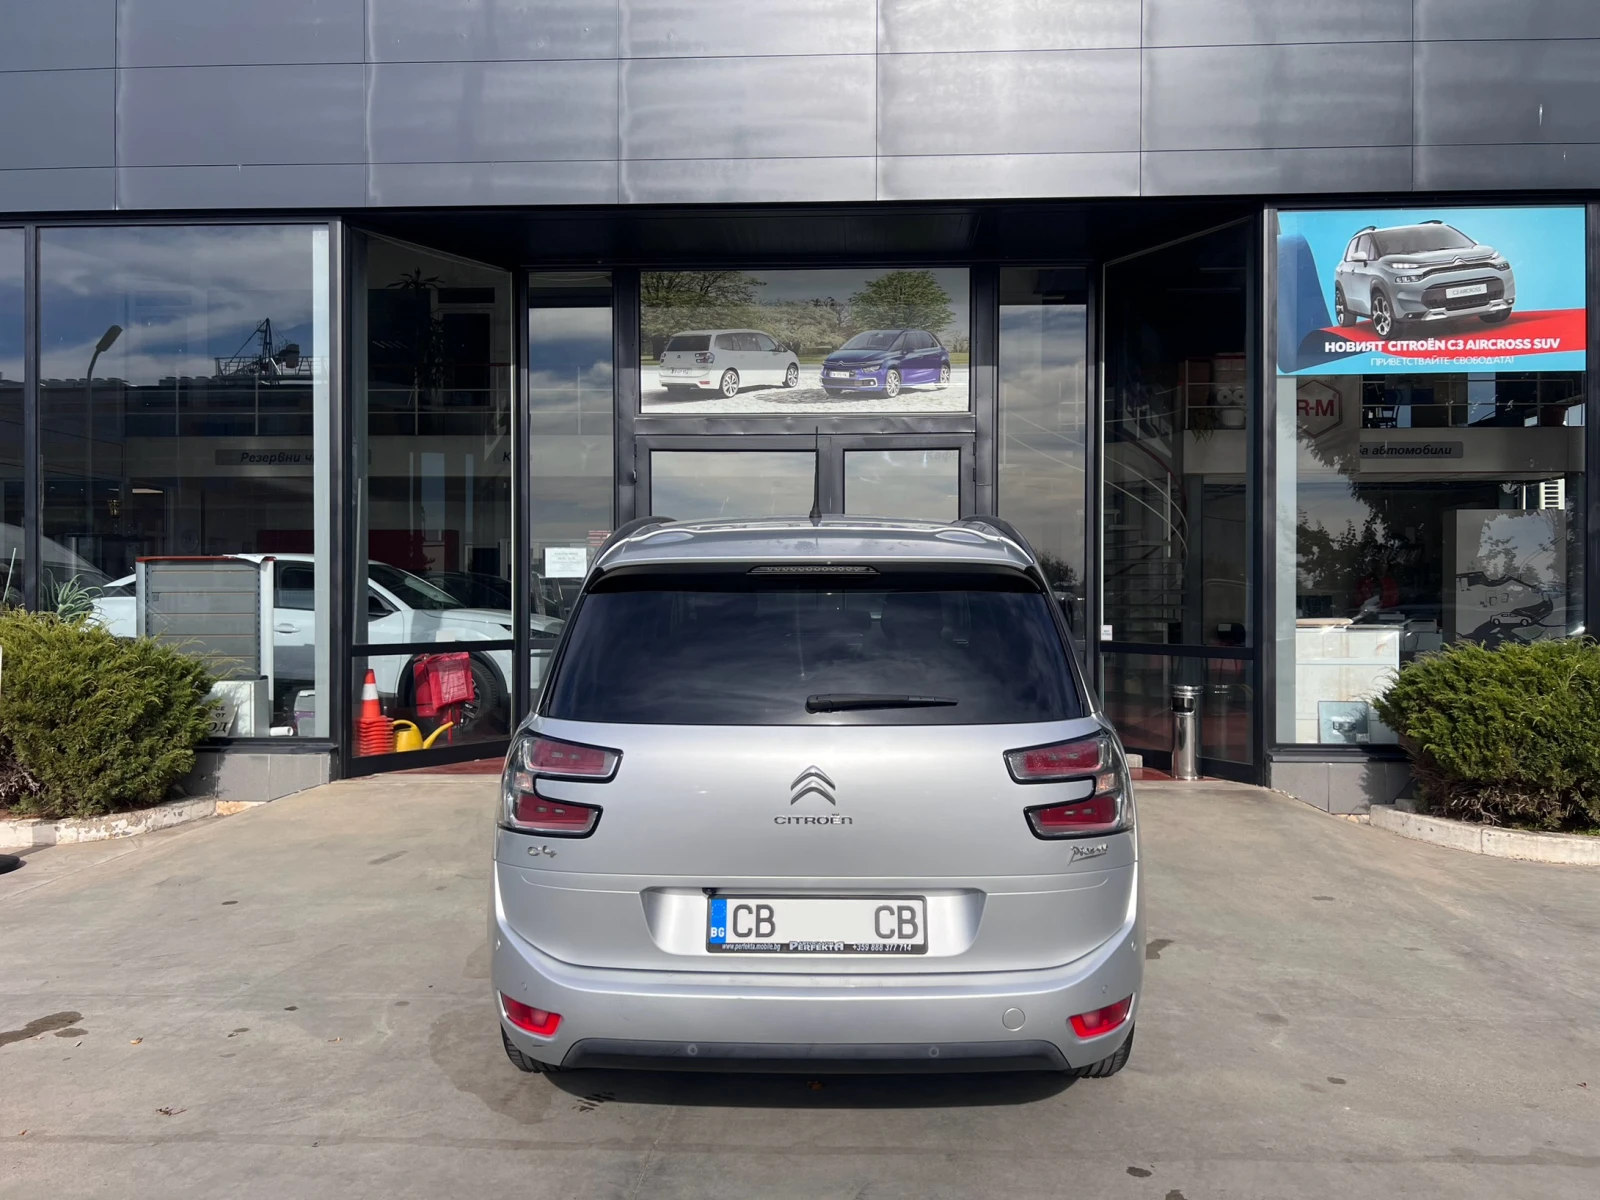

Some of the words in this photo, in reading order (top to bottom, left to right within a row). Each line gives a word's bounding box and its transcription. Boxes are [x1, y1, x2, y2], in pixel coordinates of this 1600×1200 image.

[1324, 341, 1385, 353] НОВИЯТ
[1388, 338, 1446, 351] CITROËN
[1447, 340, 1464, 350] C3
[1466, 339, 1532, 349] AIRCROSS
[1534, 338, 1560, 349] SUV
[1370, 355, 1451, 366] ПРИВЕТСТВАЙТЕ
[1453, 356, 1514, 366] СВОБОДАТА!
[1296, 399, 1334, 417] R-M
[1372, 444, 1452, 455] автомобили
[240, 452, 301, 465] Резервни
[527, 845, 557, 858] C4
[732, 904, 776, 938] CB
[874, 905, 919, 939] CB
[710, 927, 725, 937] BG
[721, 943, 781, 952] www.perfekta.mobile.bg
[789, 941, 844, 951] PERFEKTA
